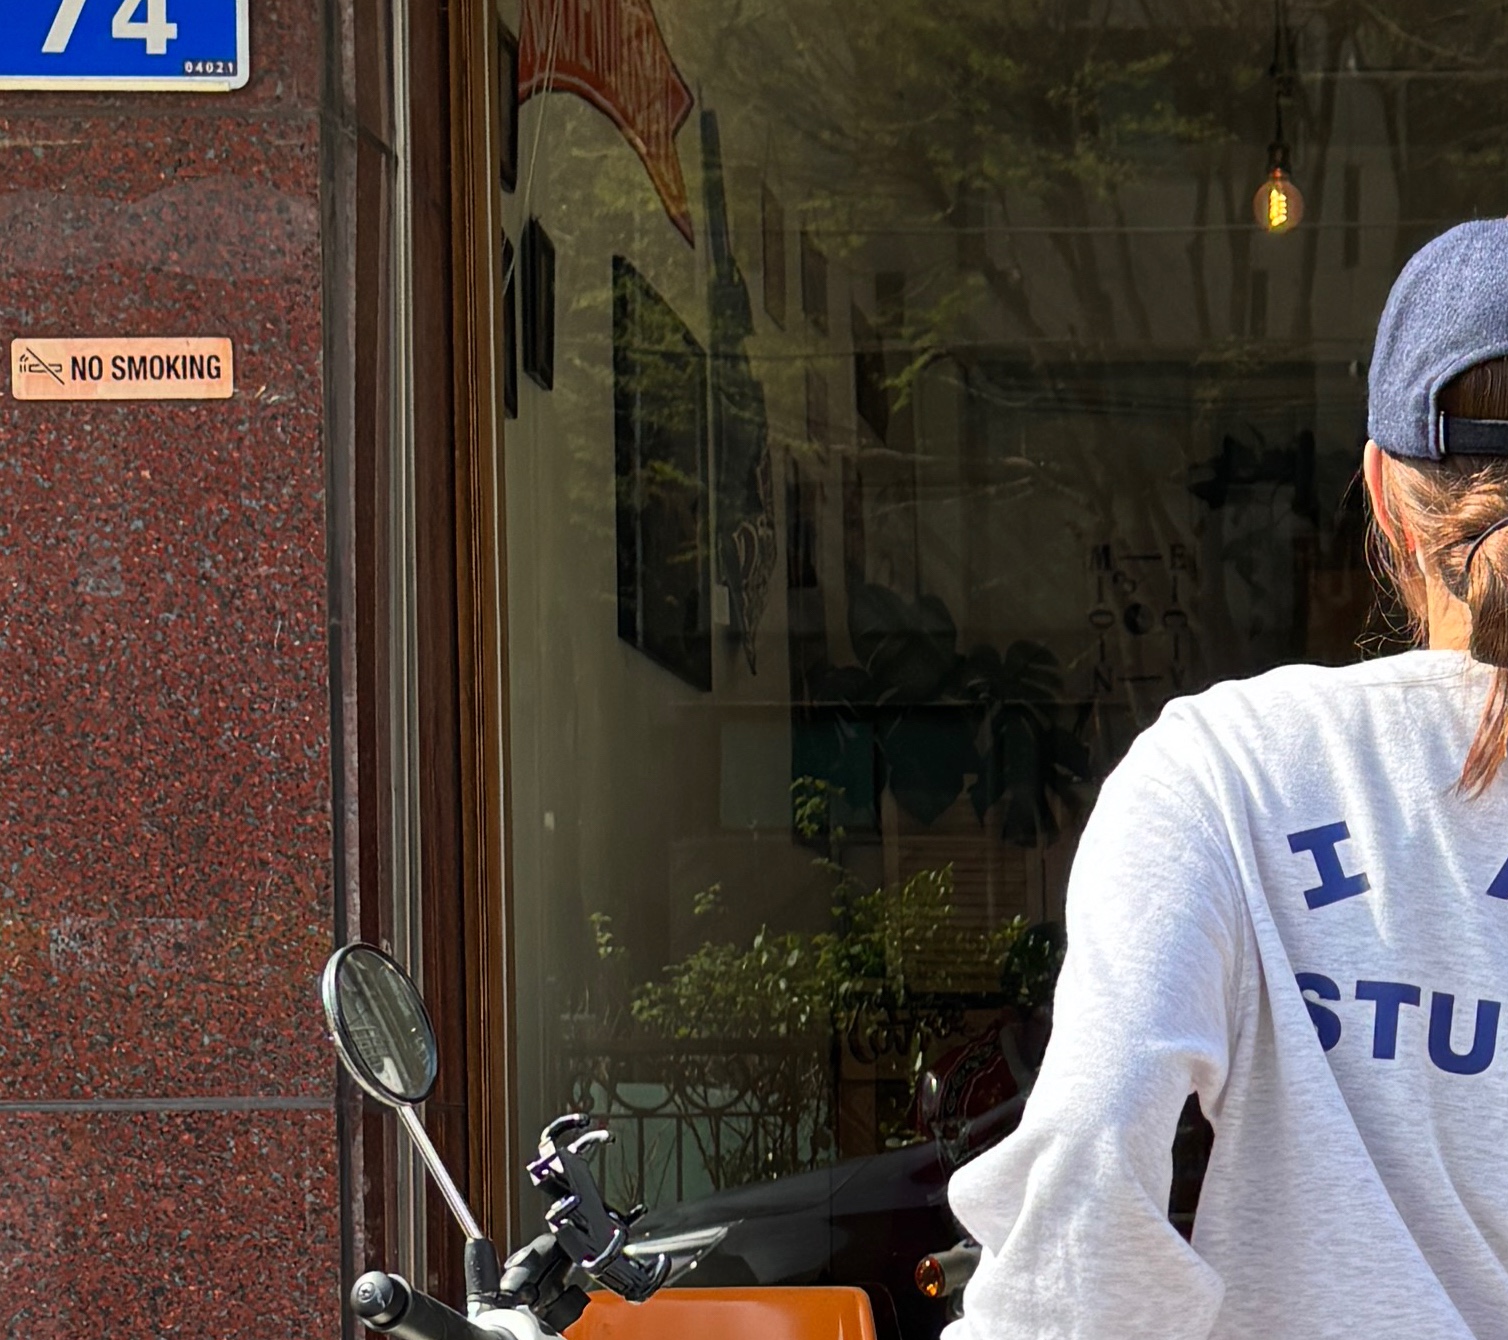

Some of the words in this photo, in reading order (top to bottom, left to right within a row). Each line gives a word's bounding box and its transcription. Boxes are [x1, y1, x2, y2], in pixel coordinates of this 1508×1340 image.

[184, 61, 234, 74] 04021
[71, 356, 103, 381] NO
[111, 355, 222, 381] SMOKING
[1286, 820, 1371, 910] I
